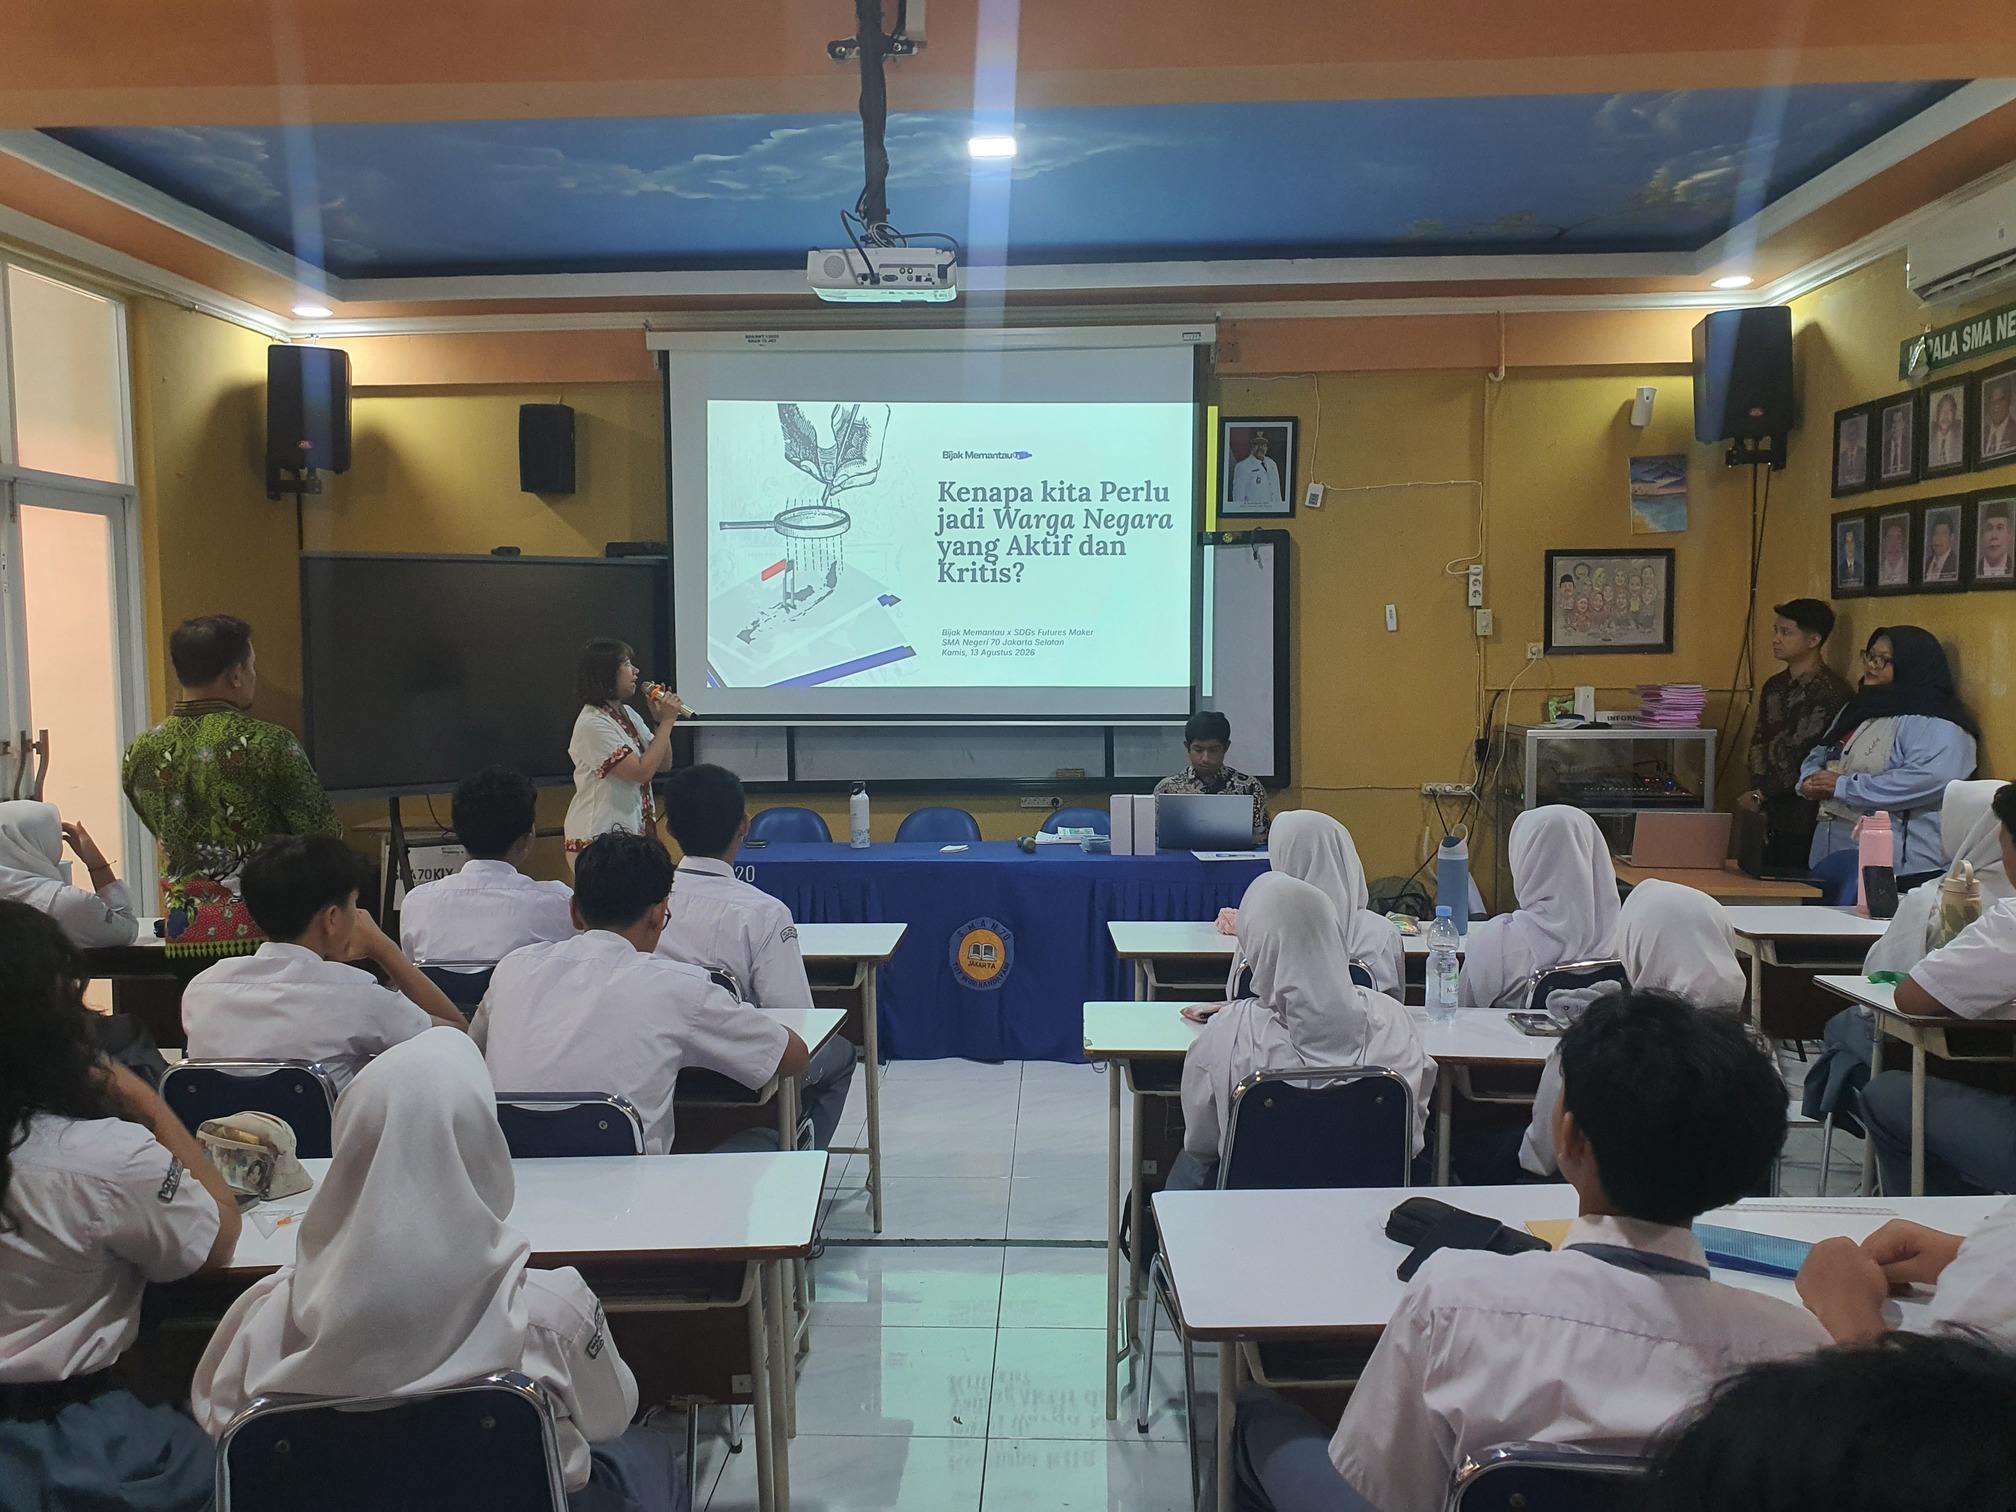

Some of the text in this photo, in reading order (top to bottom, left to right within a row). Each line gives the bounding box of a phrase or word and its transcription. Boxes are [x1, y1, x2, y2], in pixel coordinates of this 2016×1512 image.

[1909, 331, 1958, 361] PALA
[1962, 319, 1992, 352] SMA
[942, 450, 1013, 461] Bijak Memantau
[938, 480, 1170, 508] Kenapa kita Perlu
[935, 508, 1173, 536] jadi Warga Negara
[937, 535, 1127, 563] yang Aktif dan
[938, 561, 1025, 583] Kritis?
[942, 628, 961, 638] Bijak
[963, 628, 1005, 637] Memantau
[1014, 628, 1036, 637] SDGs
[1038, 628, 1067, 636] Futures
[1069, 628, 1094, 636] Maker
[942, 638, 1065, 648] SMA Negeri 70 Jakarta Selatan
[942, 648, 1036, 658] Kamis, 13 Agustus 2026
[999, 928, 1011, 941] 70
[967, 960, 996, 969] JAKARTA
